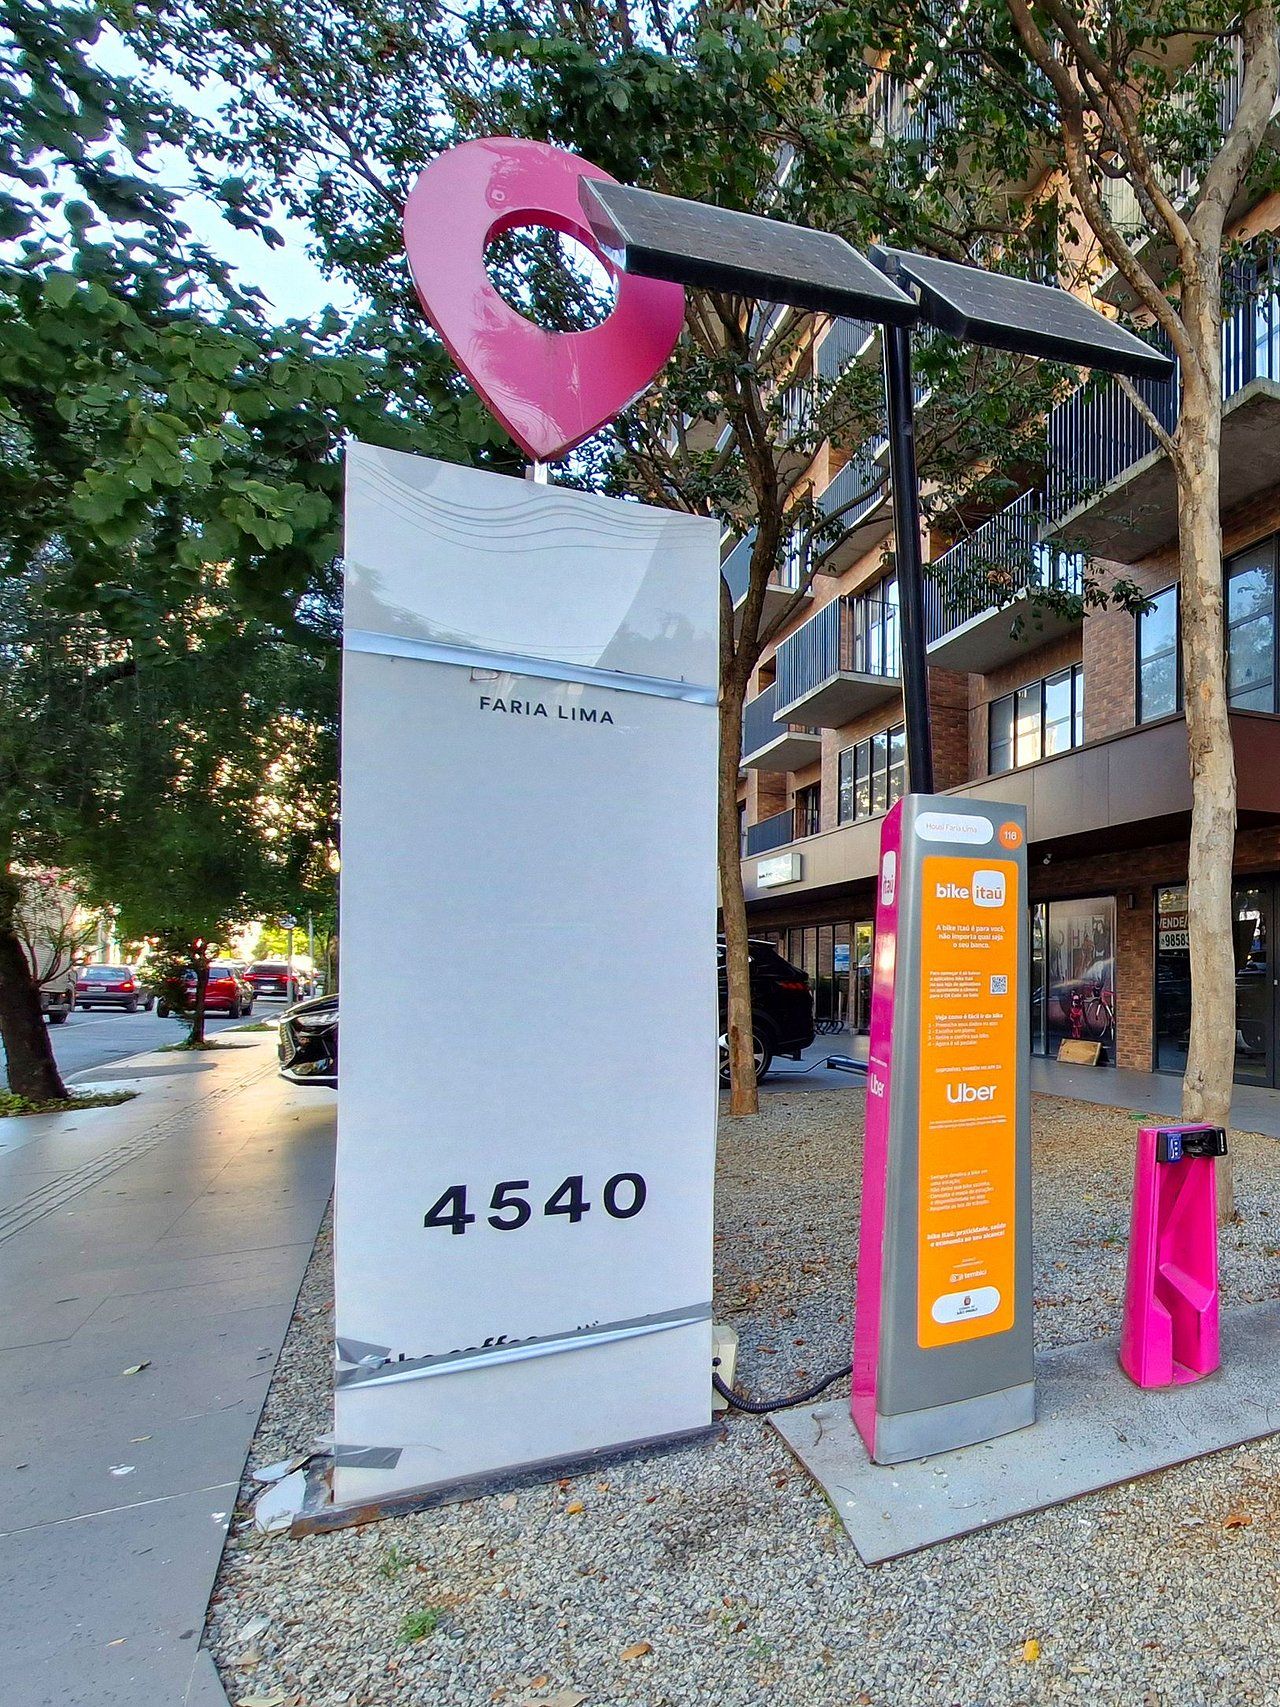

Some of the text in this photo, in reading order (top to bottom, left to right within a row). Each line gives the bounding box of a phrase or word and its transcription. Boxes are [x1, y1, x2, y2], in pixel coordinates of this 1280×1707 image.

[479, 696, 614, 725] FARIA LIMA
[1004, 831, 1017, 840] 118
[936, 883, 1002, 900] bike itaú
[871, 1073, 885, 1098] Uber
[946, 1082, 997, 1103] Uber
[423, 1172, 647, 1235] 4540
